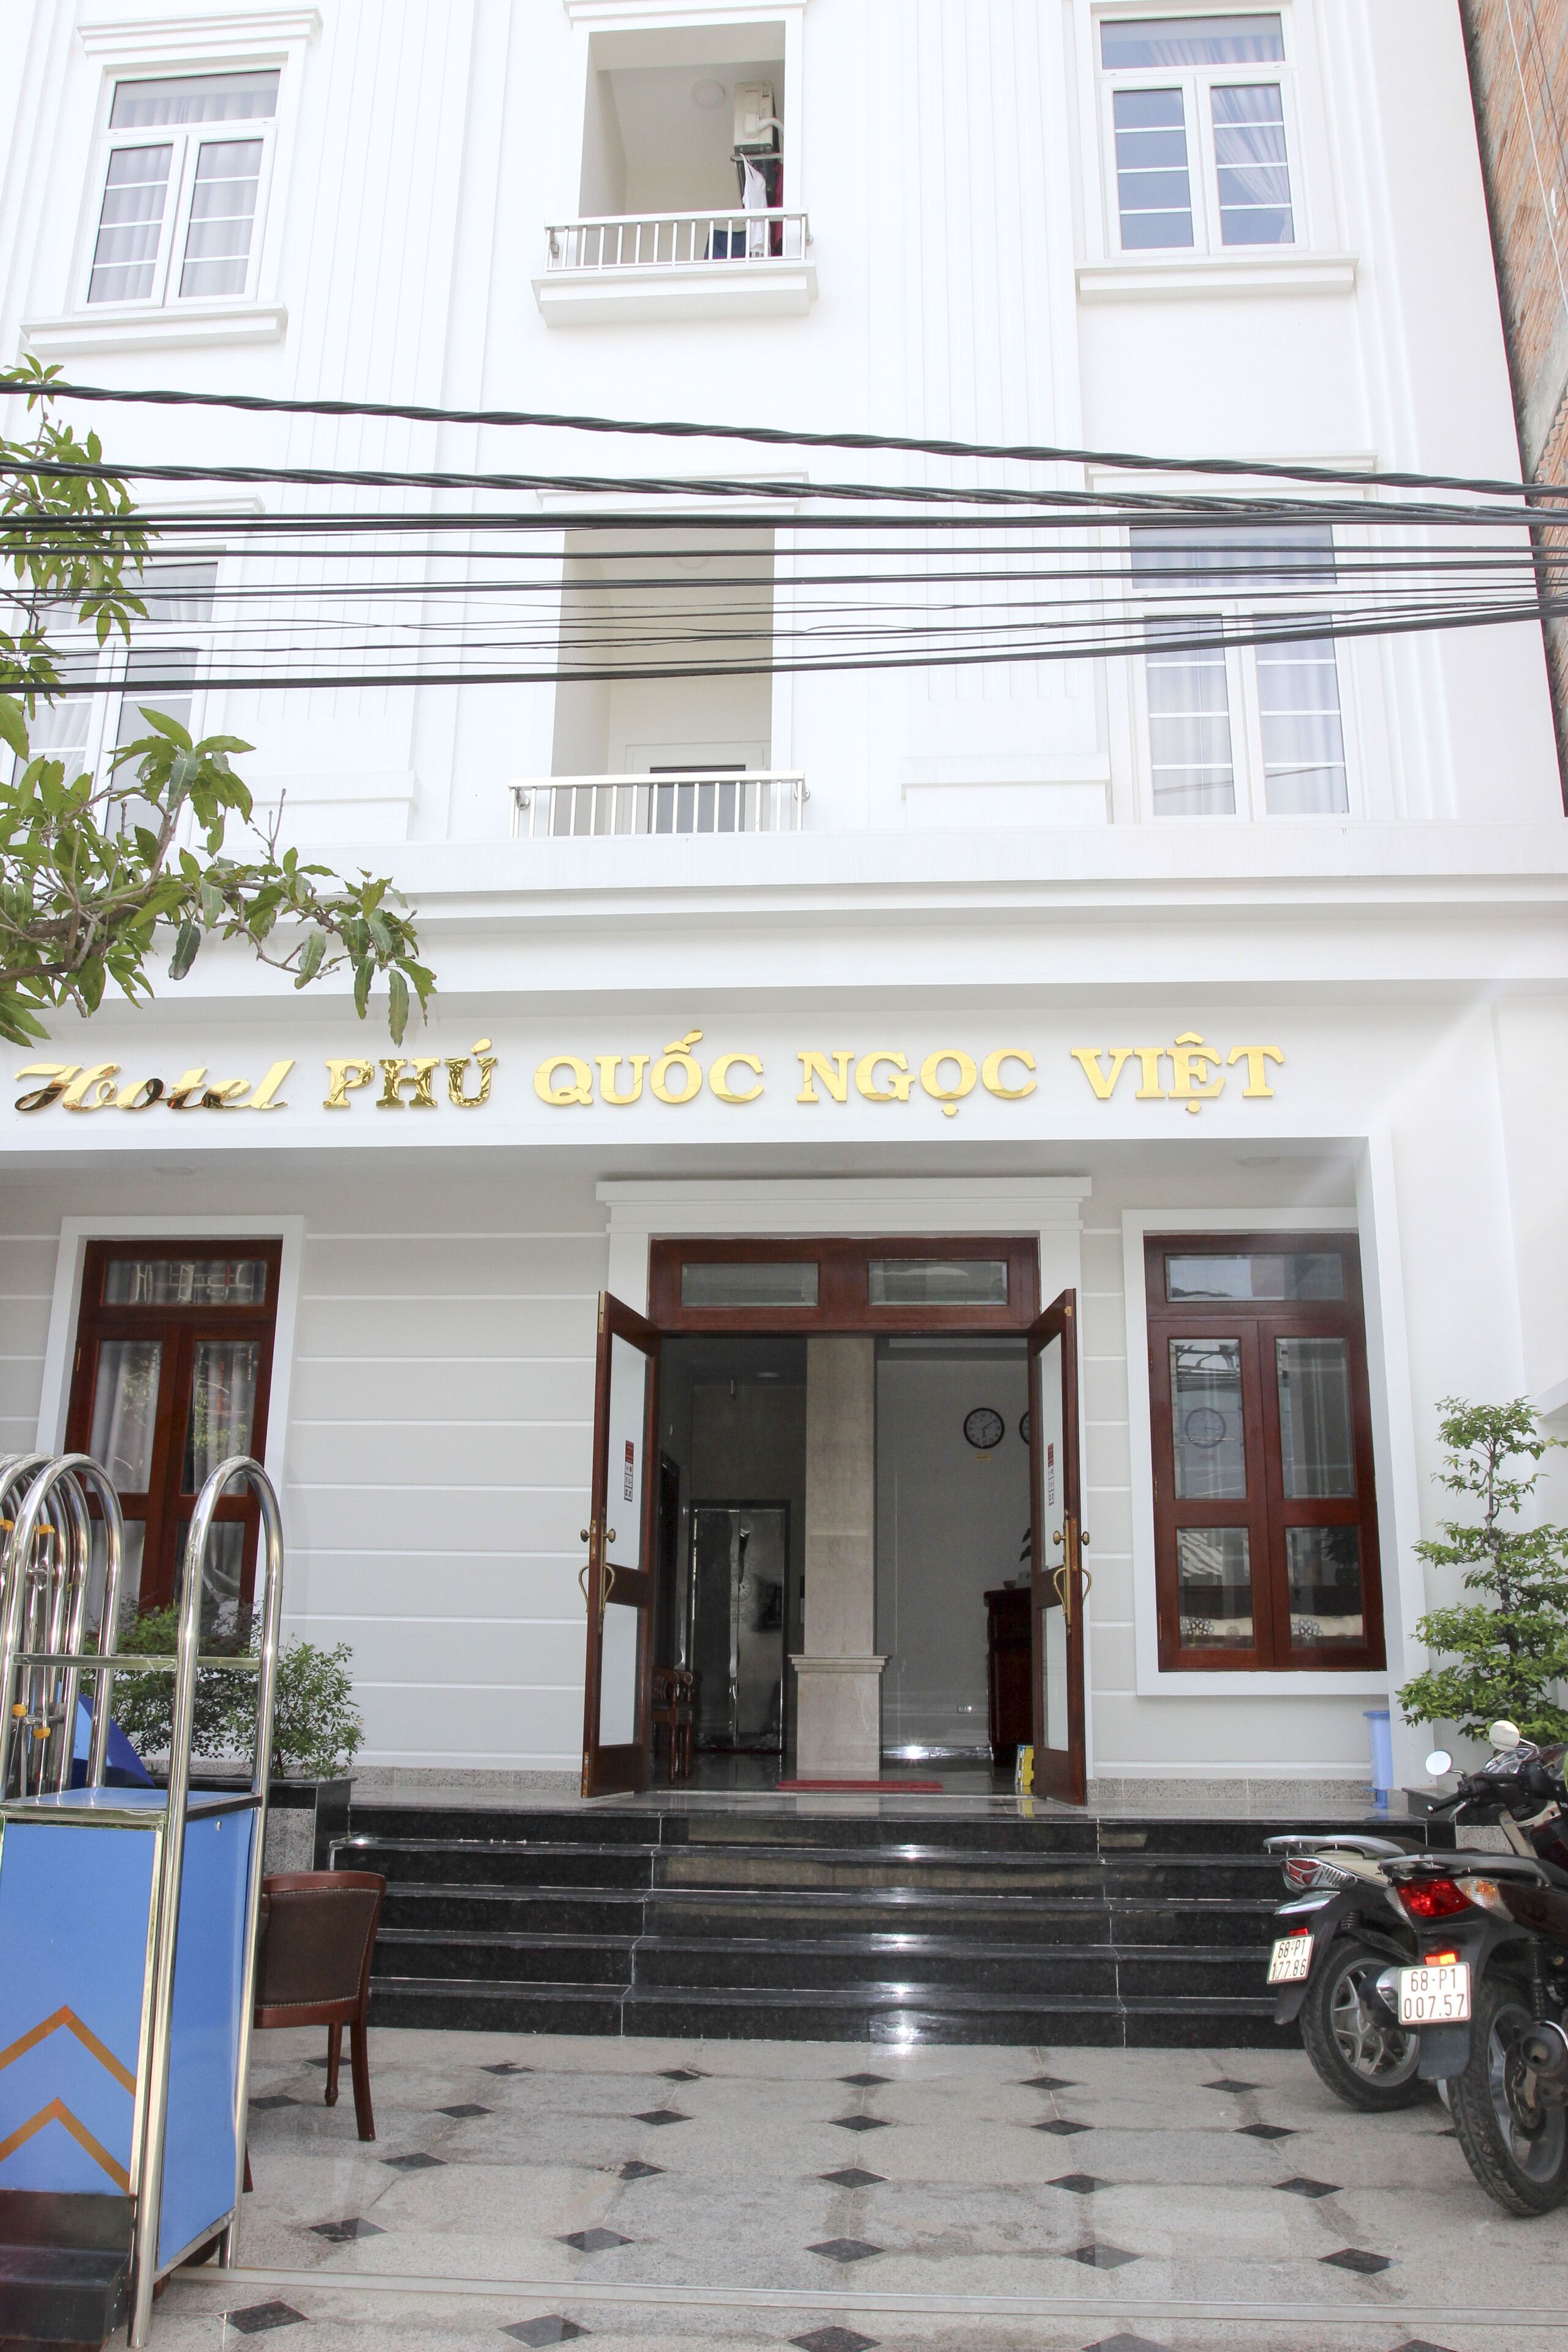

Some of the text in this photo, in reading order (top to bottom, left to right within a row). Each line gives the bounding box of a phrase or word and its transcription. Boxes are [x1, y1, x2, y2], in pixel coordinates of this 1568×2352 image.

[13, 1030, 1285, 1118] Hotel PHÚ QUỐC NGỌC VIỆT
[1272, 1959, 1306, 1980] 177.86
[1404, 1994, 1464, 2019] 007.57
